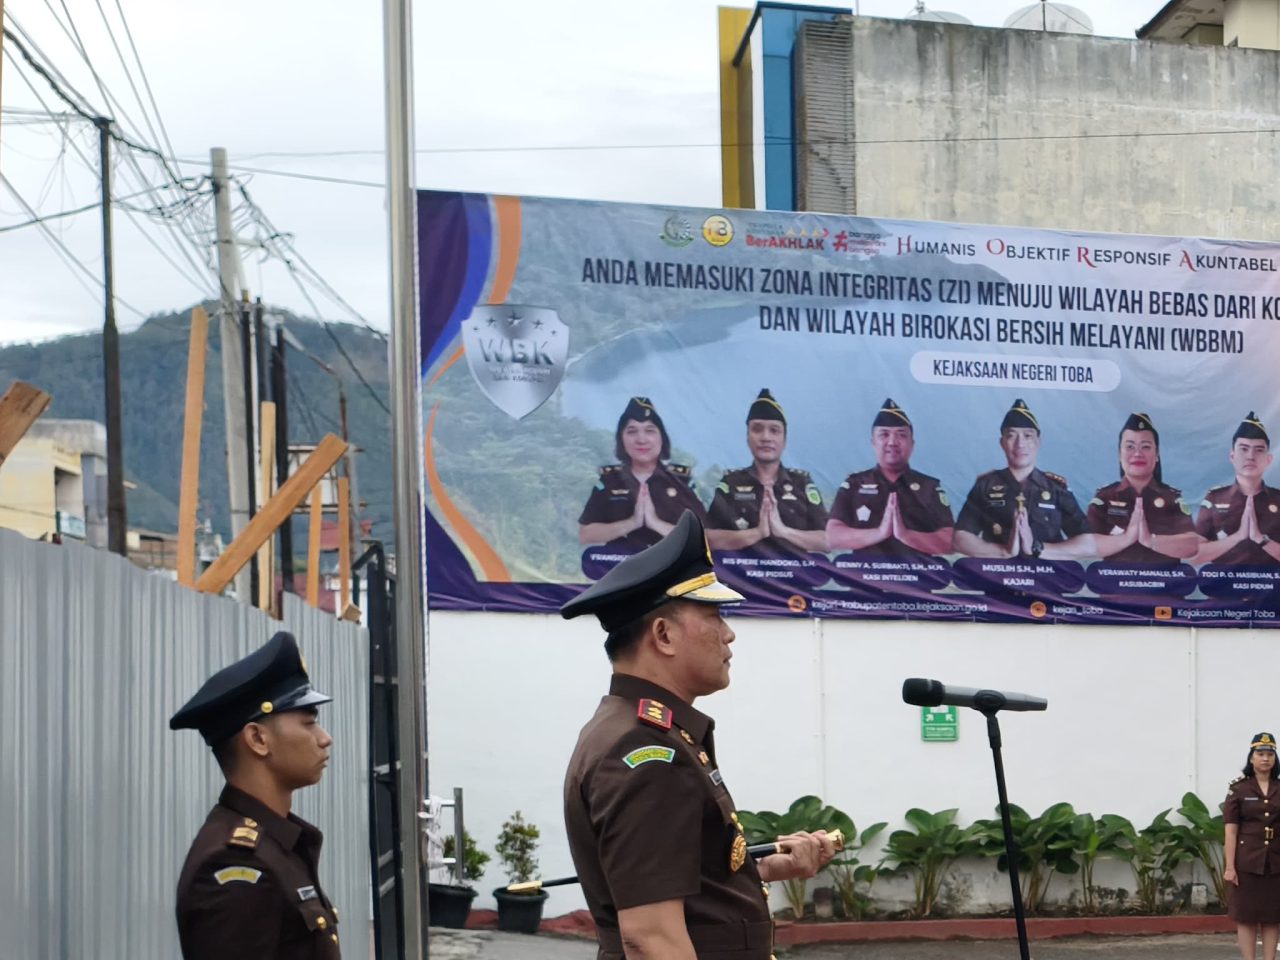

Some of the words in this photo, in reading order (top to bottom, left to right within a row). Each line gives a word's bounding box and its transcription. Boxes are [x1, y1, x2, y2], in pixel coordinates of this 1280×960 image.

[746, 234, 825, 250] BerAKHLAK
[897, 235, 976, 256] HUMANIS
[986, 239, 1070, 261] OBJEKTIF
[1077, 246, 1172, 267] RESPONSIF
[1179, 250, 1277, 272] AKUNTABEL
[582, 258, 638, 285] ANDA
[645, 261, 754, 292] MEMASUKI
[760, 268, 813, 296] ZONA
[820, 272, 932, 302] INTEGRITAS
[939, 279, 971, 304] (ZI)
[977, 281, 1053, 309] MENUJU
[1059, 285, 1143, 315] WILAYAH
[1149, 290, 1208, 317] BEBAS
[1214, 294, 1256, 319] DARI
[760, 305, 799, 331] DAN
[806, 309, 895, 337] WILAYAH
[901, 313, 990, 341] BIROKASI
[996, 318, 1064, 346] BERSIH
[1070, 322, 1165, 350] MELAYANI
[1171, 328, 1244, 354] (WBBM)
[479, 338, 554, 365] WBK
[933, 360, 1008, 380] KEJAKSAAN
[1012, 364, 1057, 382] NEGERI
[1062, 366, 1093, 383] TOBA
[982, 564, 1015, 573] MUSLIH
[1003, 578, 1035, 586] KAJARI
[1177, 608, 1223, 619] Kejaksaan
[1224, 609, 1252, 620] Negeri
[1253, 609, 1276, 618] Toba
